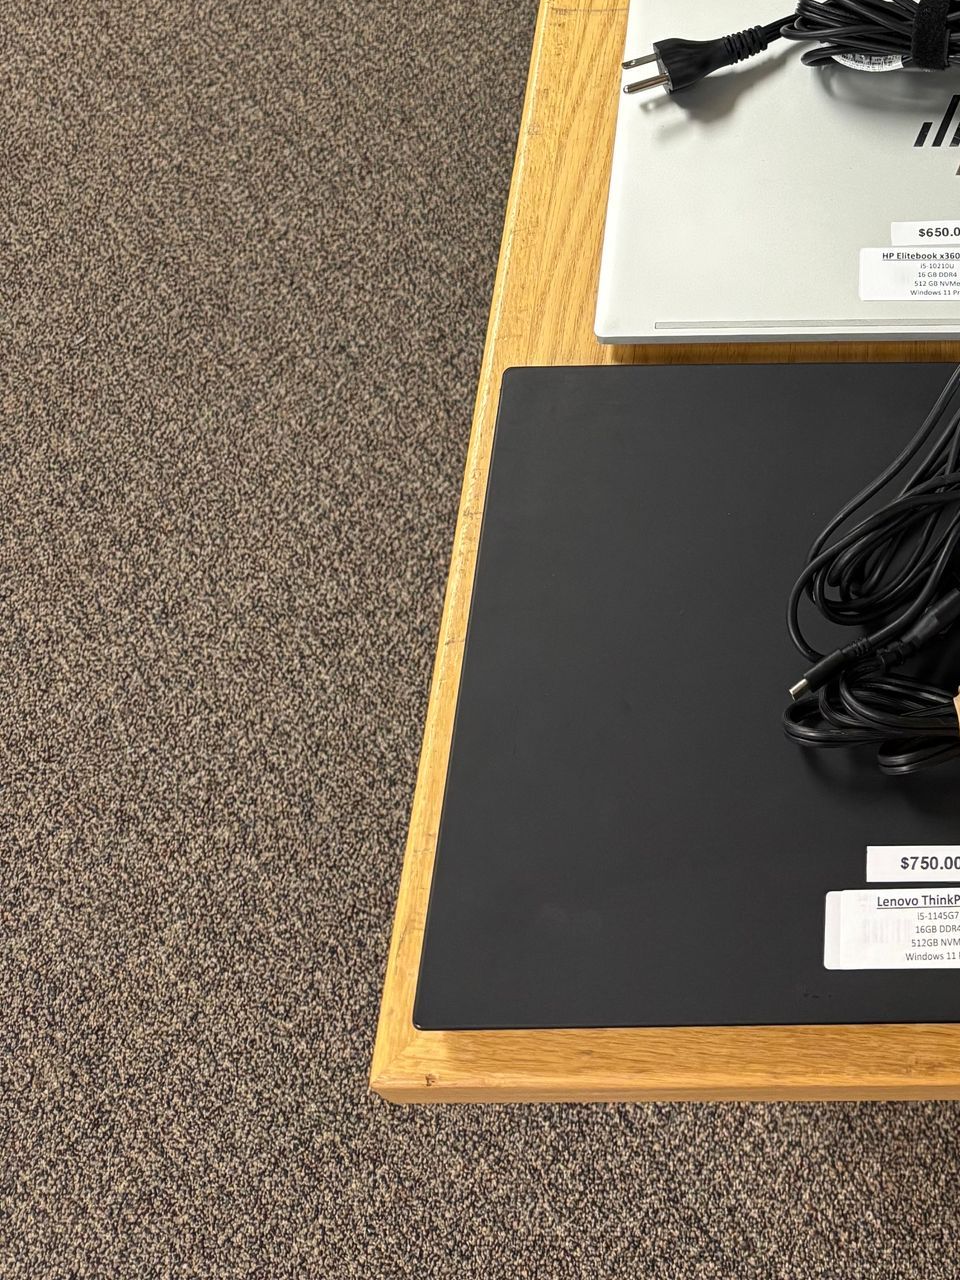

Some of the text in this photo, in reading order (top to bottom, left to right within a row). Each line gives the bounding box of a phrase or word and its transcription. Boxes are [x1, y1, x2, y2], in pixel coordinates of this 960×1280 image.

[882, 252, 895, 260] HP
[897, 252, 937, 260] Elitebook
[940, 252, 960, 260] x360
[877, 896, 919, 908] Lenovo
[917, 912, 959, 920] i5-1145G7
[911, 939, 938, 947] 512GB
[905, 952, 944, 961] Windows
[947, 952, 956, 960] 11
